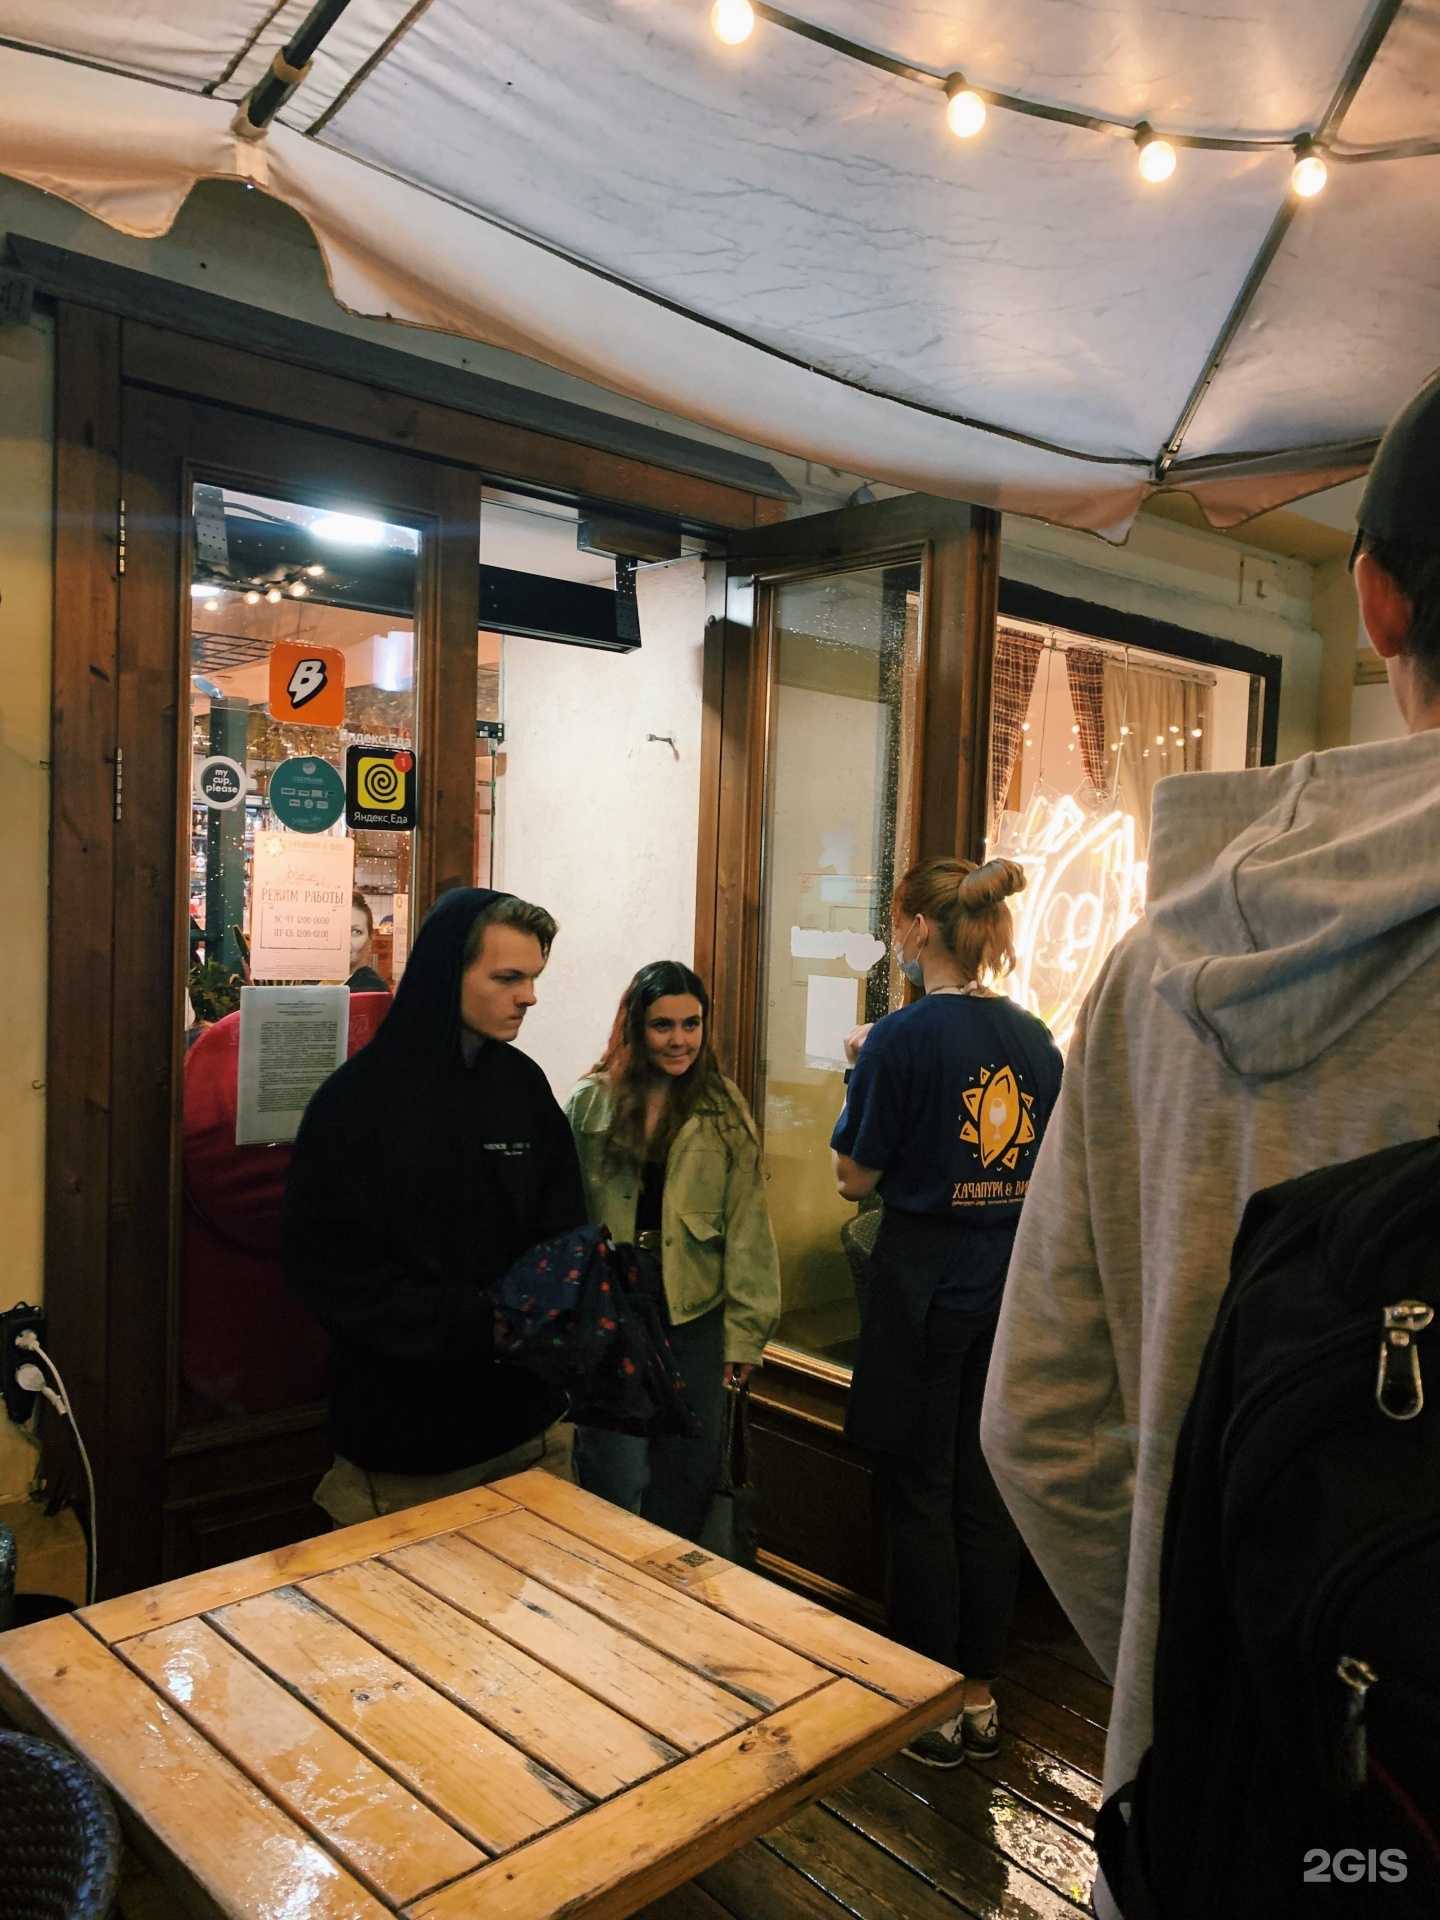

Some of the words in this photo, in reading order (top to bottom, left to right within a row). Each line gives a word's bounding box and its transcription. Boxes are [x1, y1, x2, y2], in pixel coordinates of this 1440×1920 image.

[215, 769, 228, 778] my
[206, 784, 238, 793] please
[262, 887, 298, 902] РЕЖИМ
[304, 890, 344, 904] РАБОТЫ
[952, 1181, 1004, 1199] ХАЧАПУРИ
[1005, 1183, 1013, 1196] &
